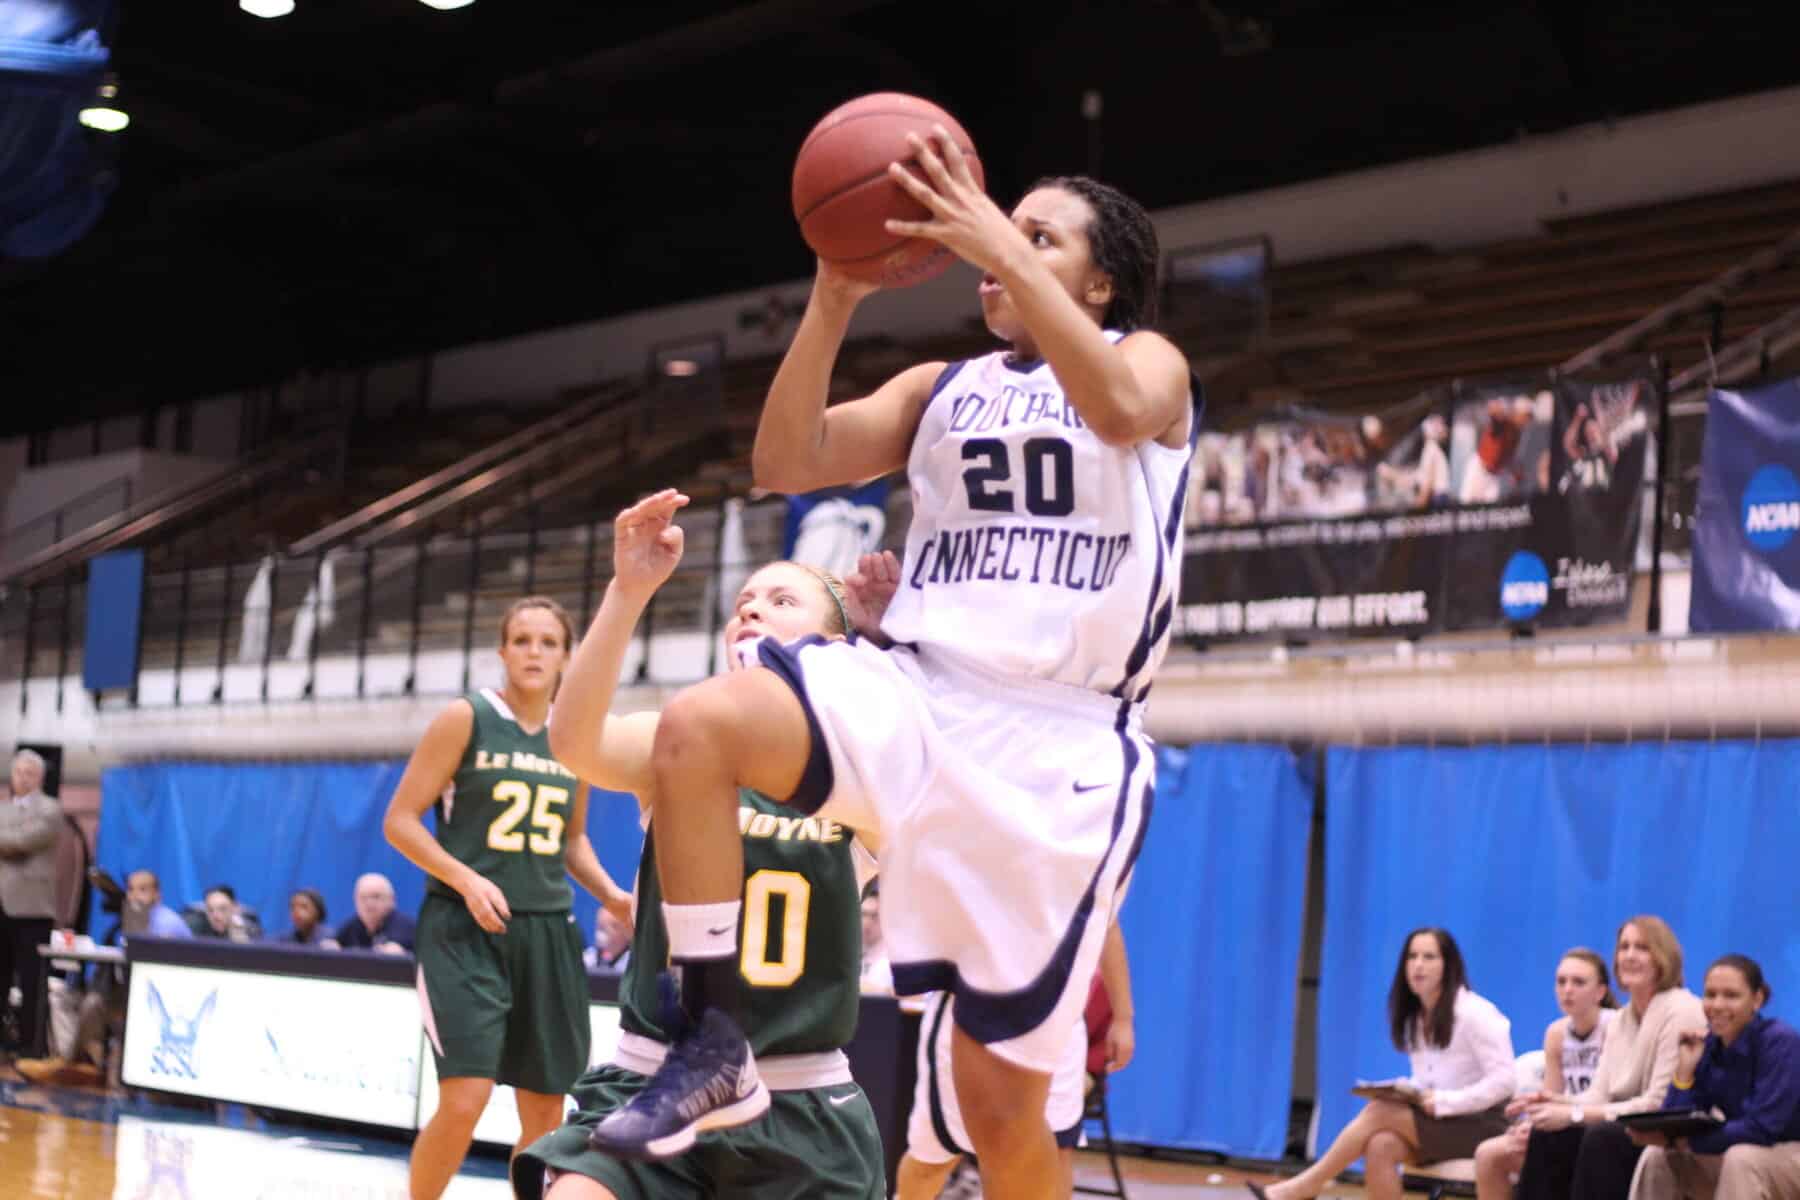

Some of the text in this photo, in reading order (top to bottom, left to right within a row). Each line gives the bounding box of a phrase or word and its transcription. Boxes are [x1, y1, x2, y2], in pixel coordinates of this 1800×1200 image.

[961, 437, 1075, 517] 20
[910, 525, 1132, 591] CNNECTICUT
[487, 779, 568, 856] 25
[740, 869, 811, 987] 0
